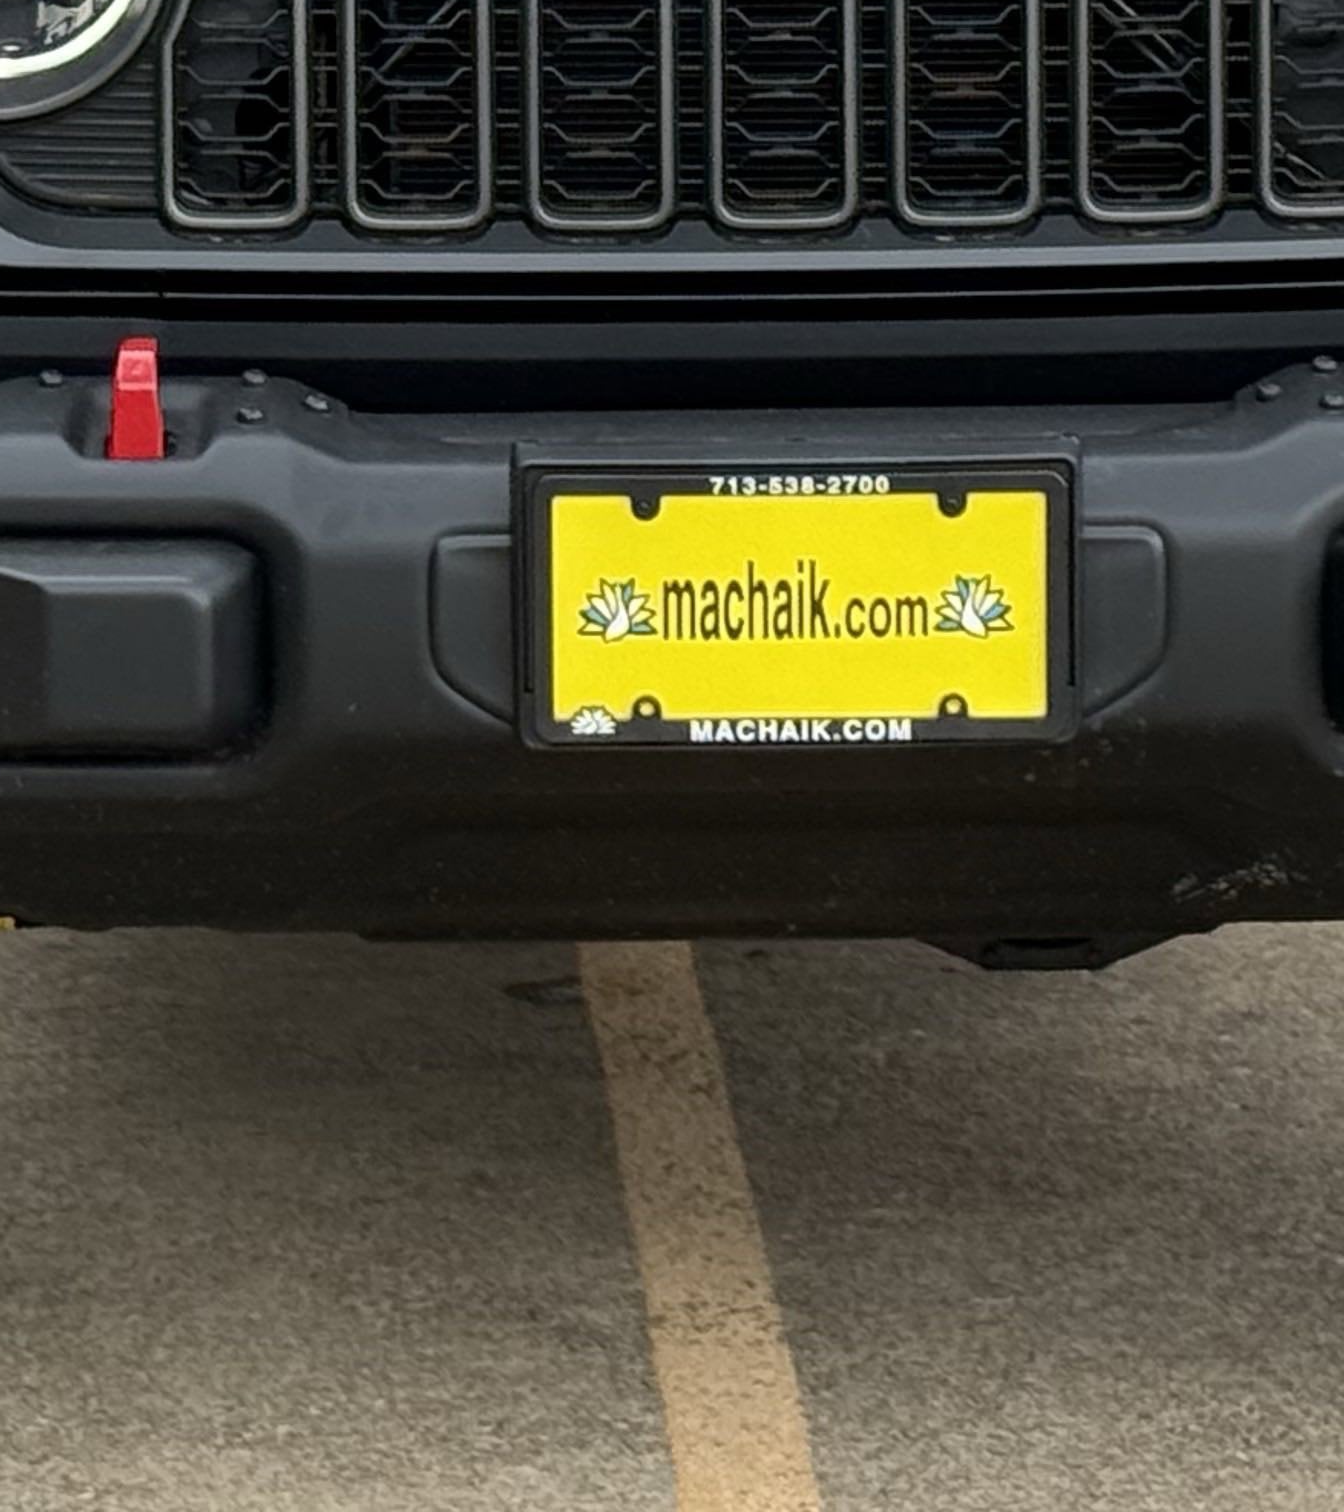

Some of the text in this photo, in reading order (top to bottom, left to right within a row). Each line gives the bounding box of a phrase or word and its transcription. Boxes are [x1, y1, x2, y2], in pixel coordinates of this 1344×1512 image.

[709, 475, 890, 496] 713-538-2700
[662, 561, 929, 641] machaik.com
[690, 719, 913, 742] MACHAIK.COM
